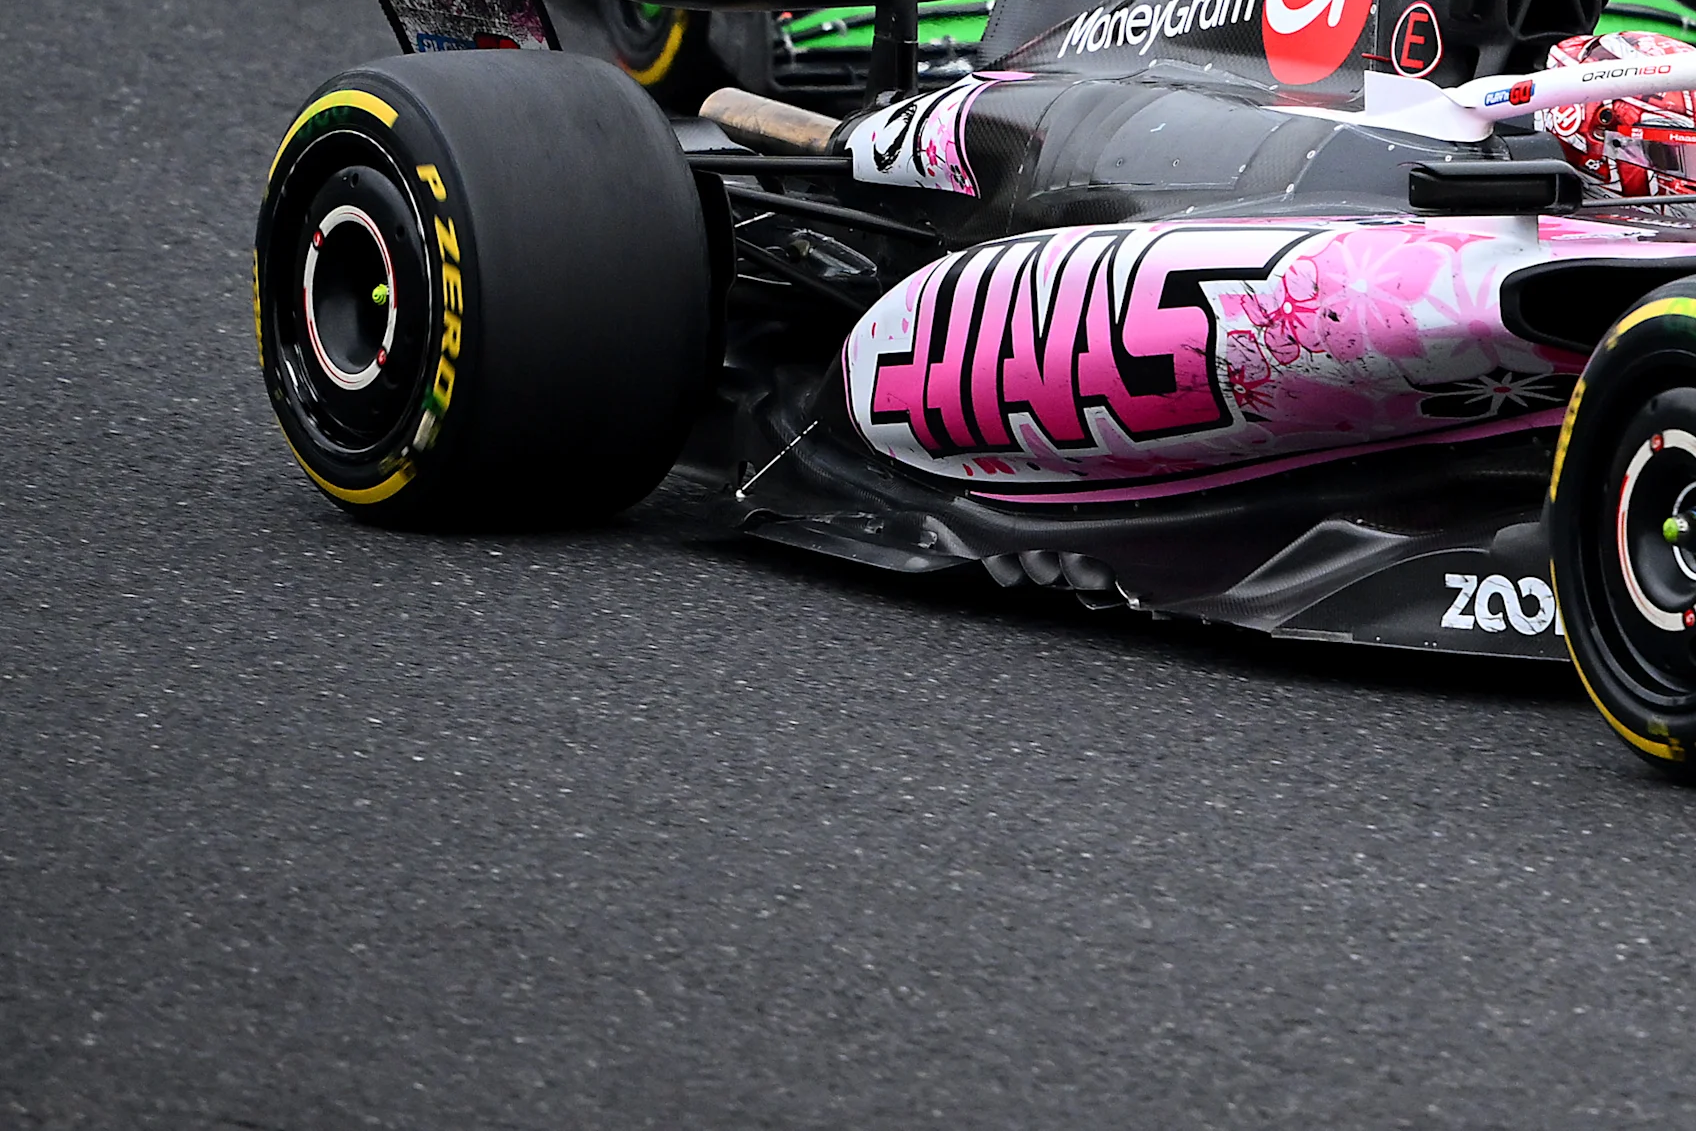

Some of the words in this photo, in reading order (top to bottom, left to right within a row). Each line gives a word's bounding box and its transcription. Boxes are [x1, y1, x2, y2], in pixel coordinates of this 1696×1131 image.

[1399, 12, 1429, 69] E
[1509, 80, 1533, 105] GO
[1582, 65, 1671, 82] ORION180
[416, 164, 447, 202] P
[432, 214, 464, 406] ZERO
[872, 228, 1316, 451] HAAS
